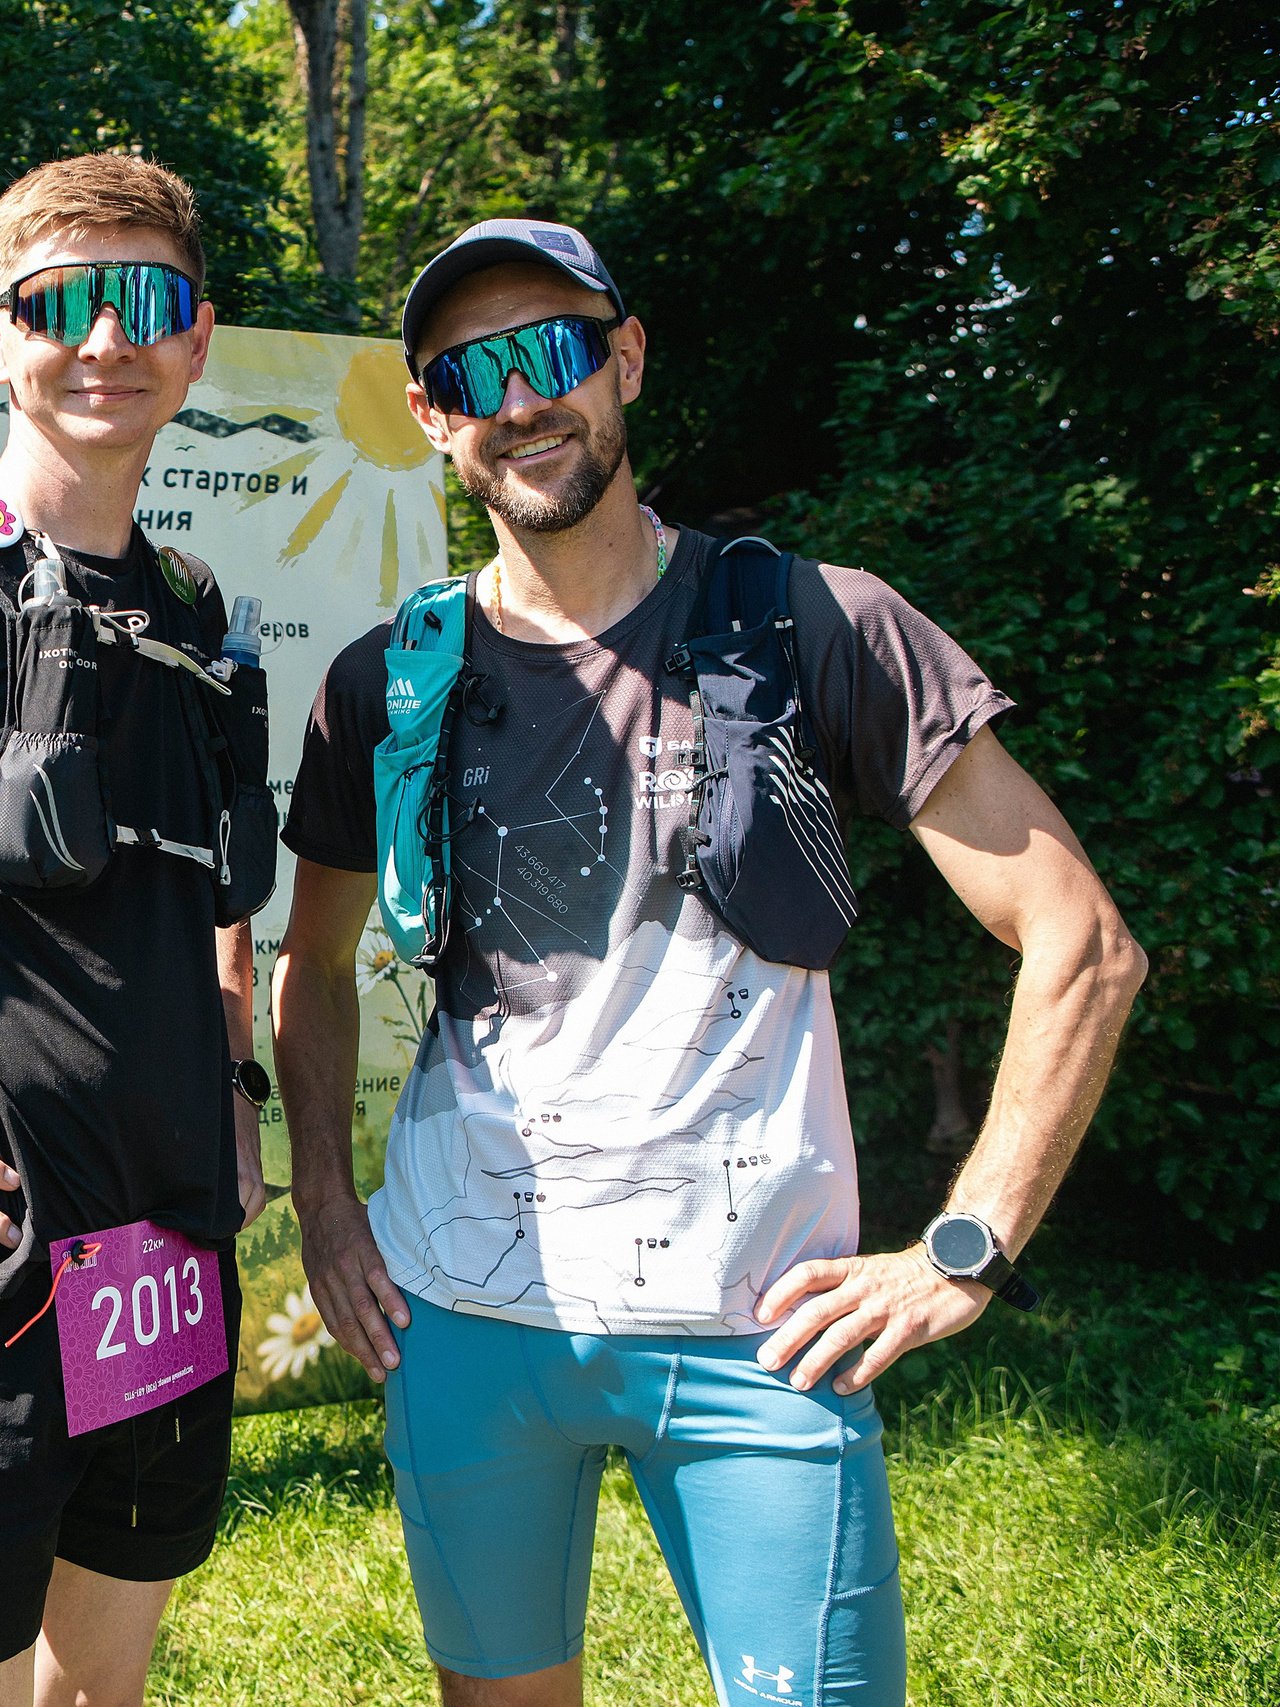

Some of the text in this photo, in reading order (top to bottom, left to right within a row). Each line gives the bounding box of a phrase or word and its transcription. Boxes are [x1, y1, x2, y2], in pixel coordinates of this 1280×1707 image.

[163, 467, 280, 497] стартов
[291, 475, 308, 496] и
[260, 621, 309, 642] еров
[386, 699, 422, 710] ONIJIE
[667, 738, 695, 752] БА
[515, 845, 549, 876] 43.660
[517, 867, 569, 914] 40.319 680
[91, 1256, 204, 1361] 2013
